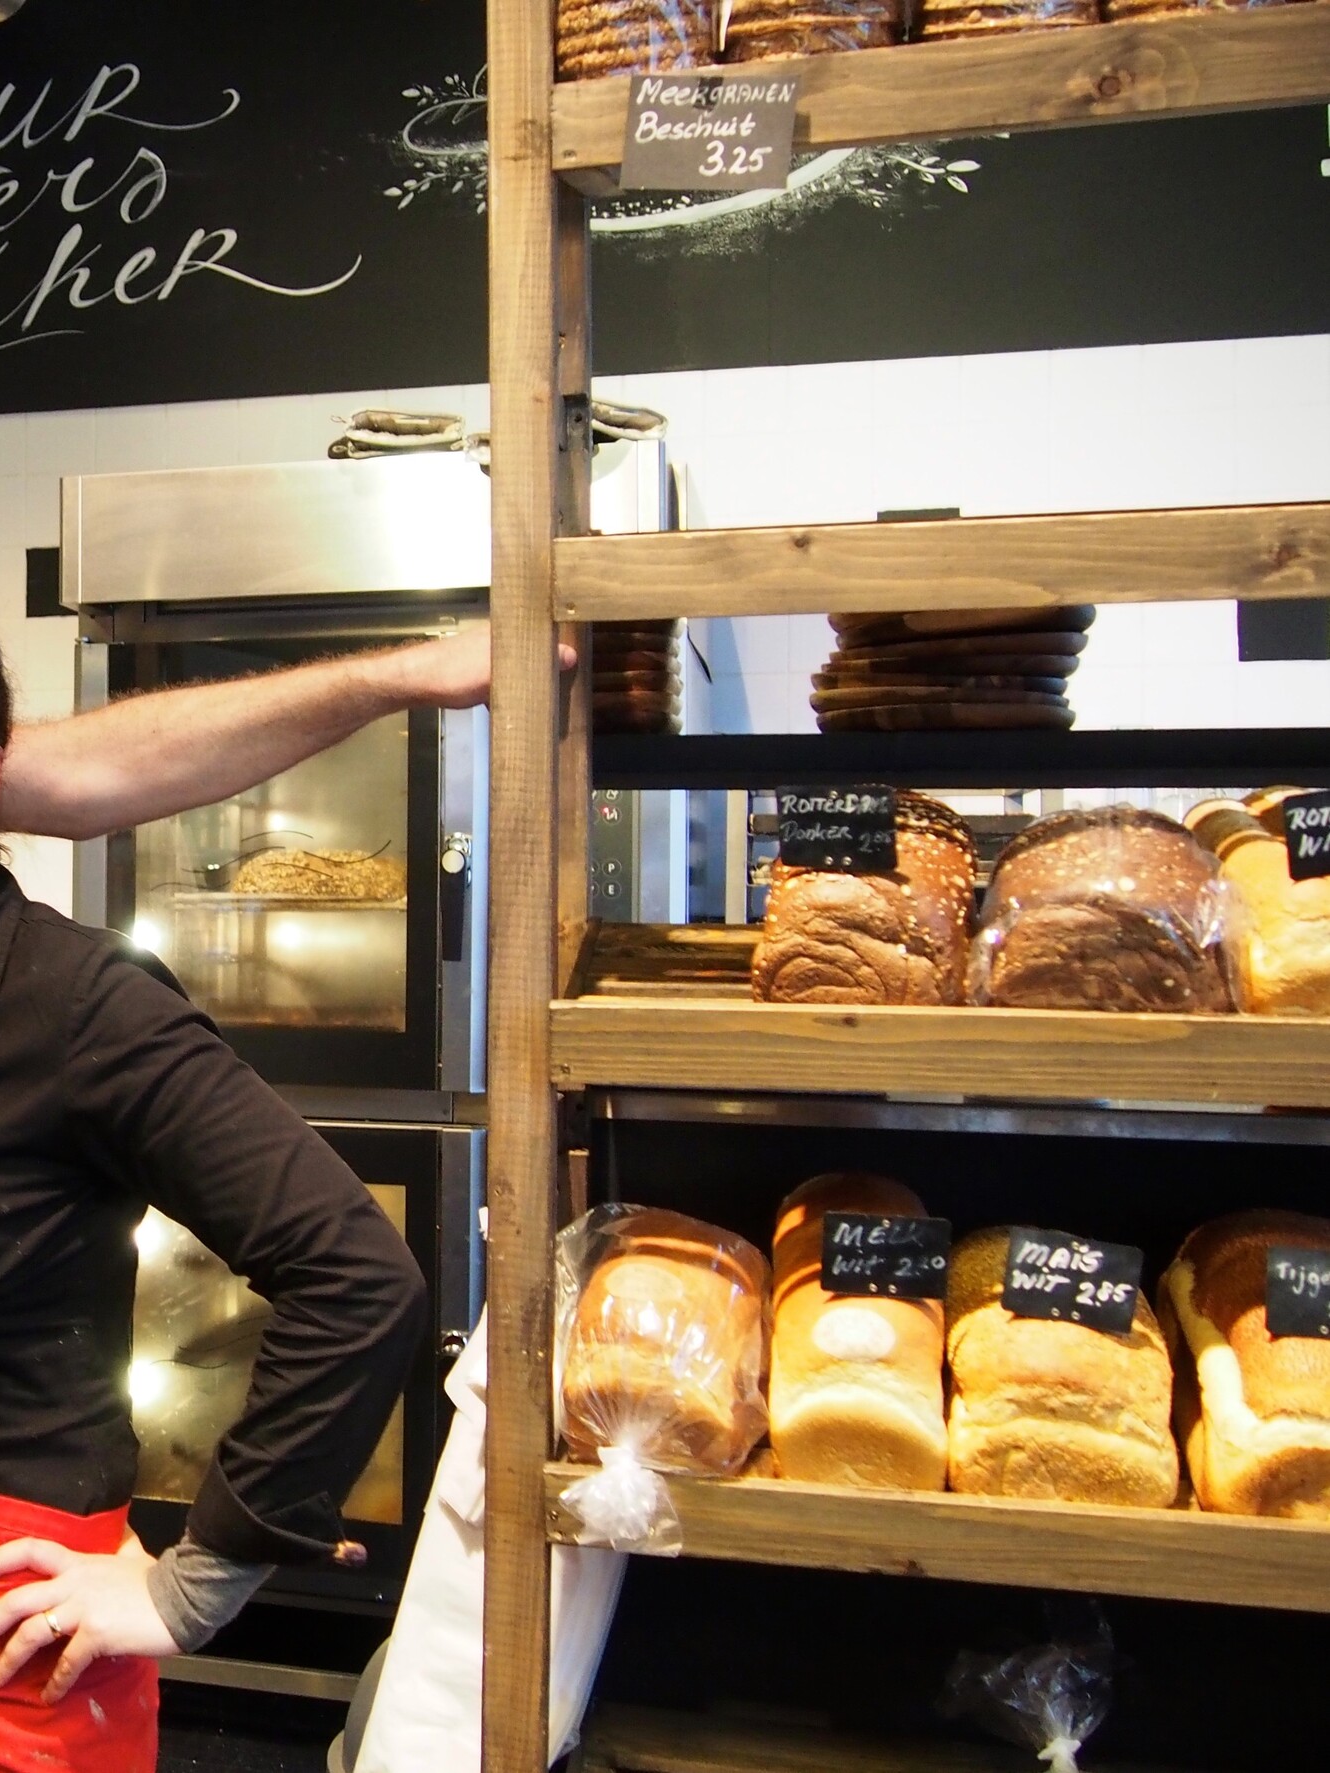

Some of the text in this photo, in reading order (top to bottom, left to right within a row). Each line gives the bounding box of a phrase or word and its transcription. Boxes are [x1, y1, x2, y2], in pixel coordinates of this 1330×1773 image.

[635, 110, 756, 143] Beschuit
[699, 140, 773, 177] 3.25
[1075, 1280, 1135, 1307] 2.85
